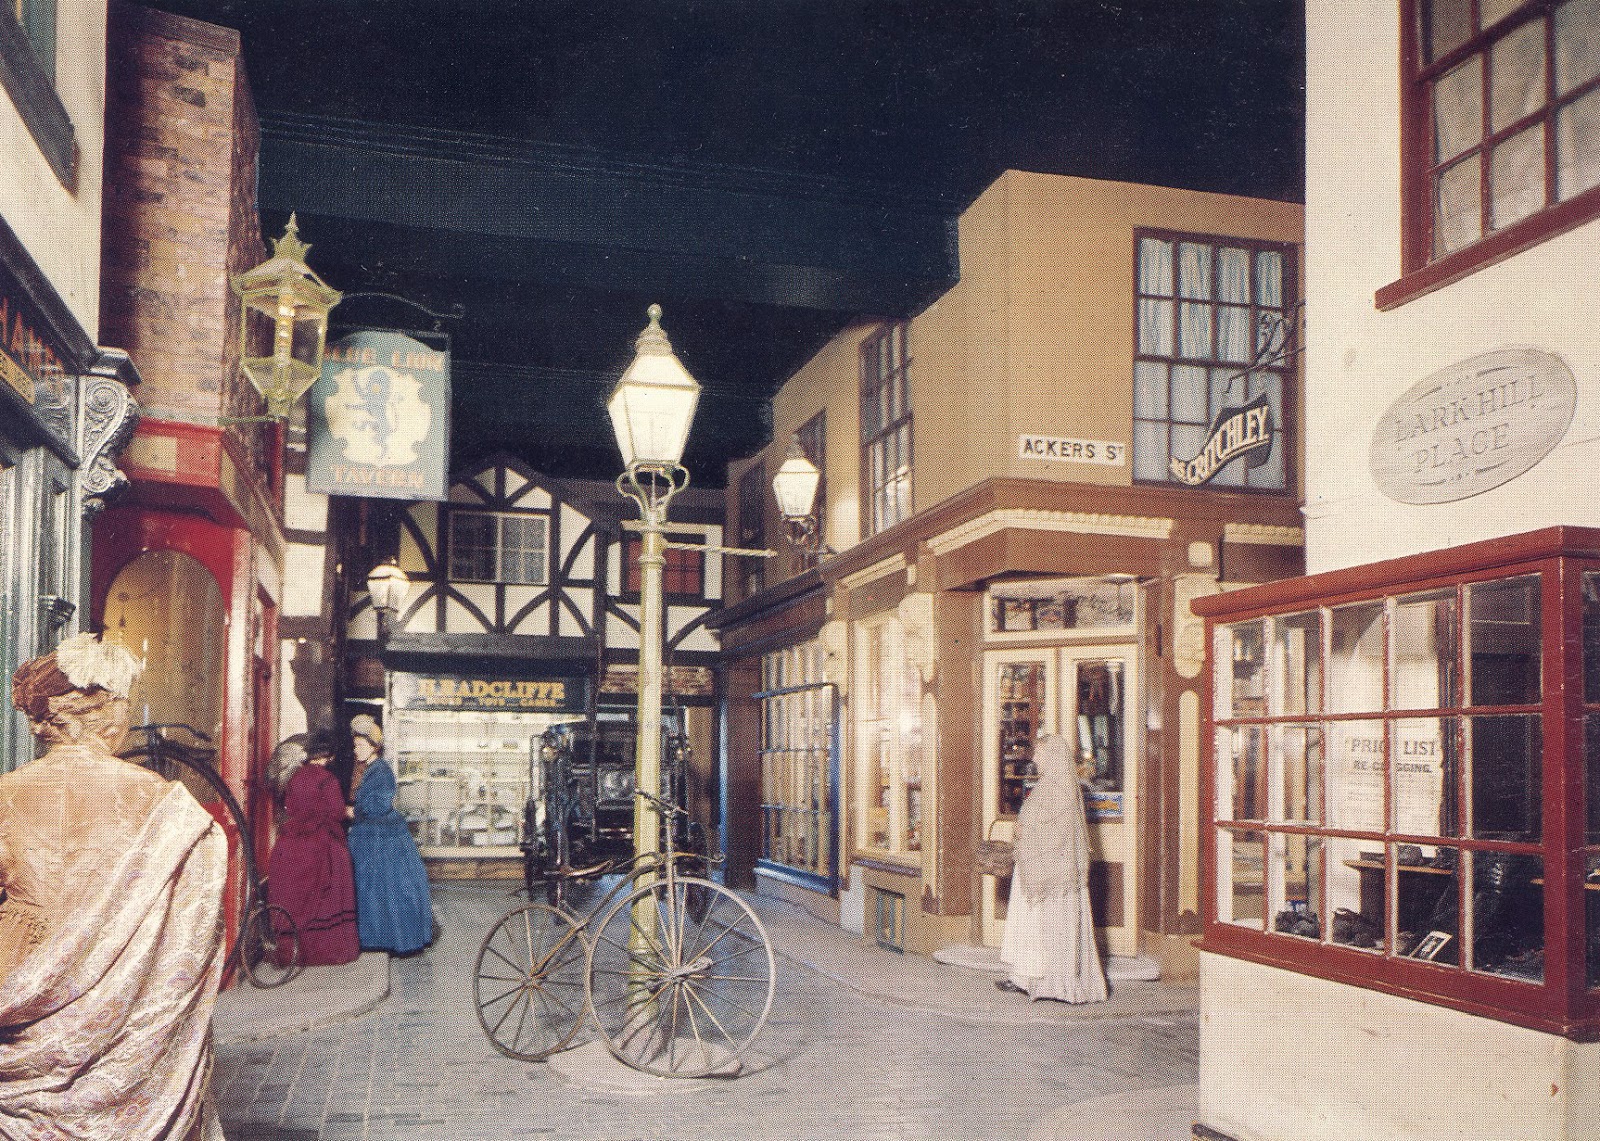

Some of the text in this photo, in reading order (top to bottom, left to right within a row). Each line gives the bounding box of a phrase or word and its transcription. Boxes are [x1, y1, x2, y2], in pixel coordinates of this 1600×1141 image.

[392, 350, 444, 372] LION
[1395, 374, 1544, 443] LARK HILL
[1023, 438, 1096, 460] ACKERS
[1412, 423, 1510, 474] PLACE
[331, 464, 425, 488] TAVERN
[1351, 738, 1435, 756] PRIC LIST
